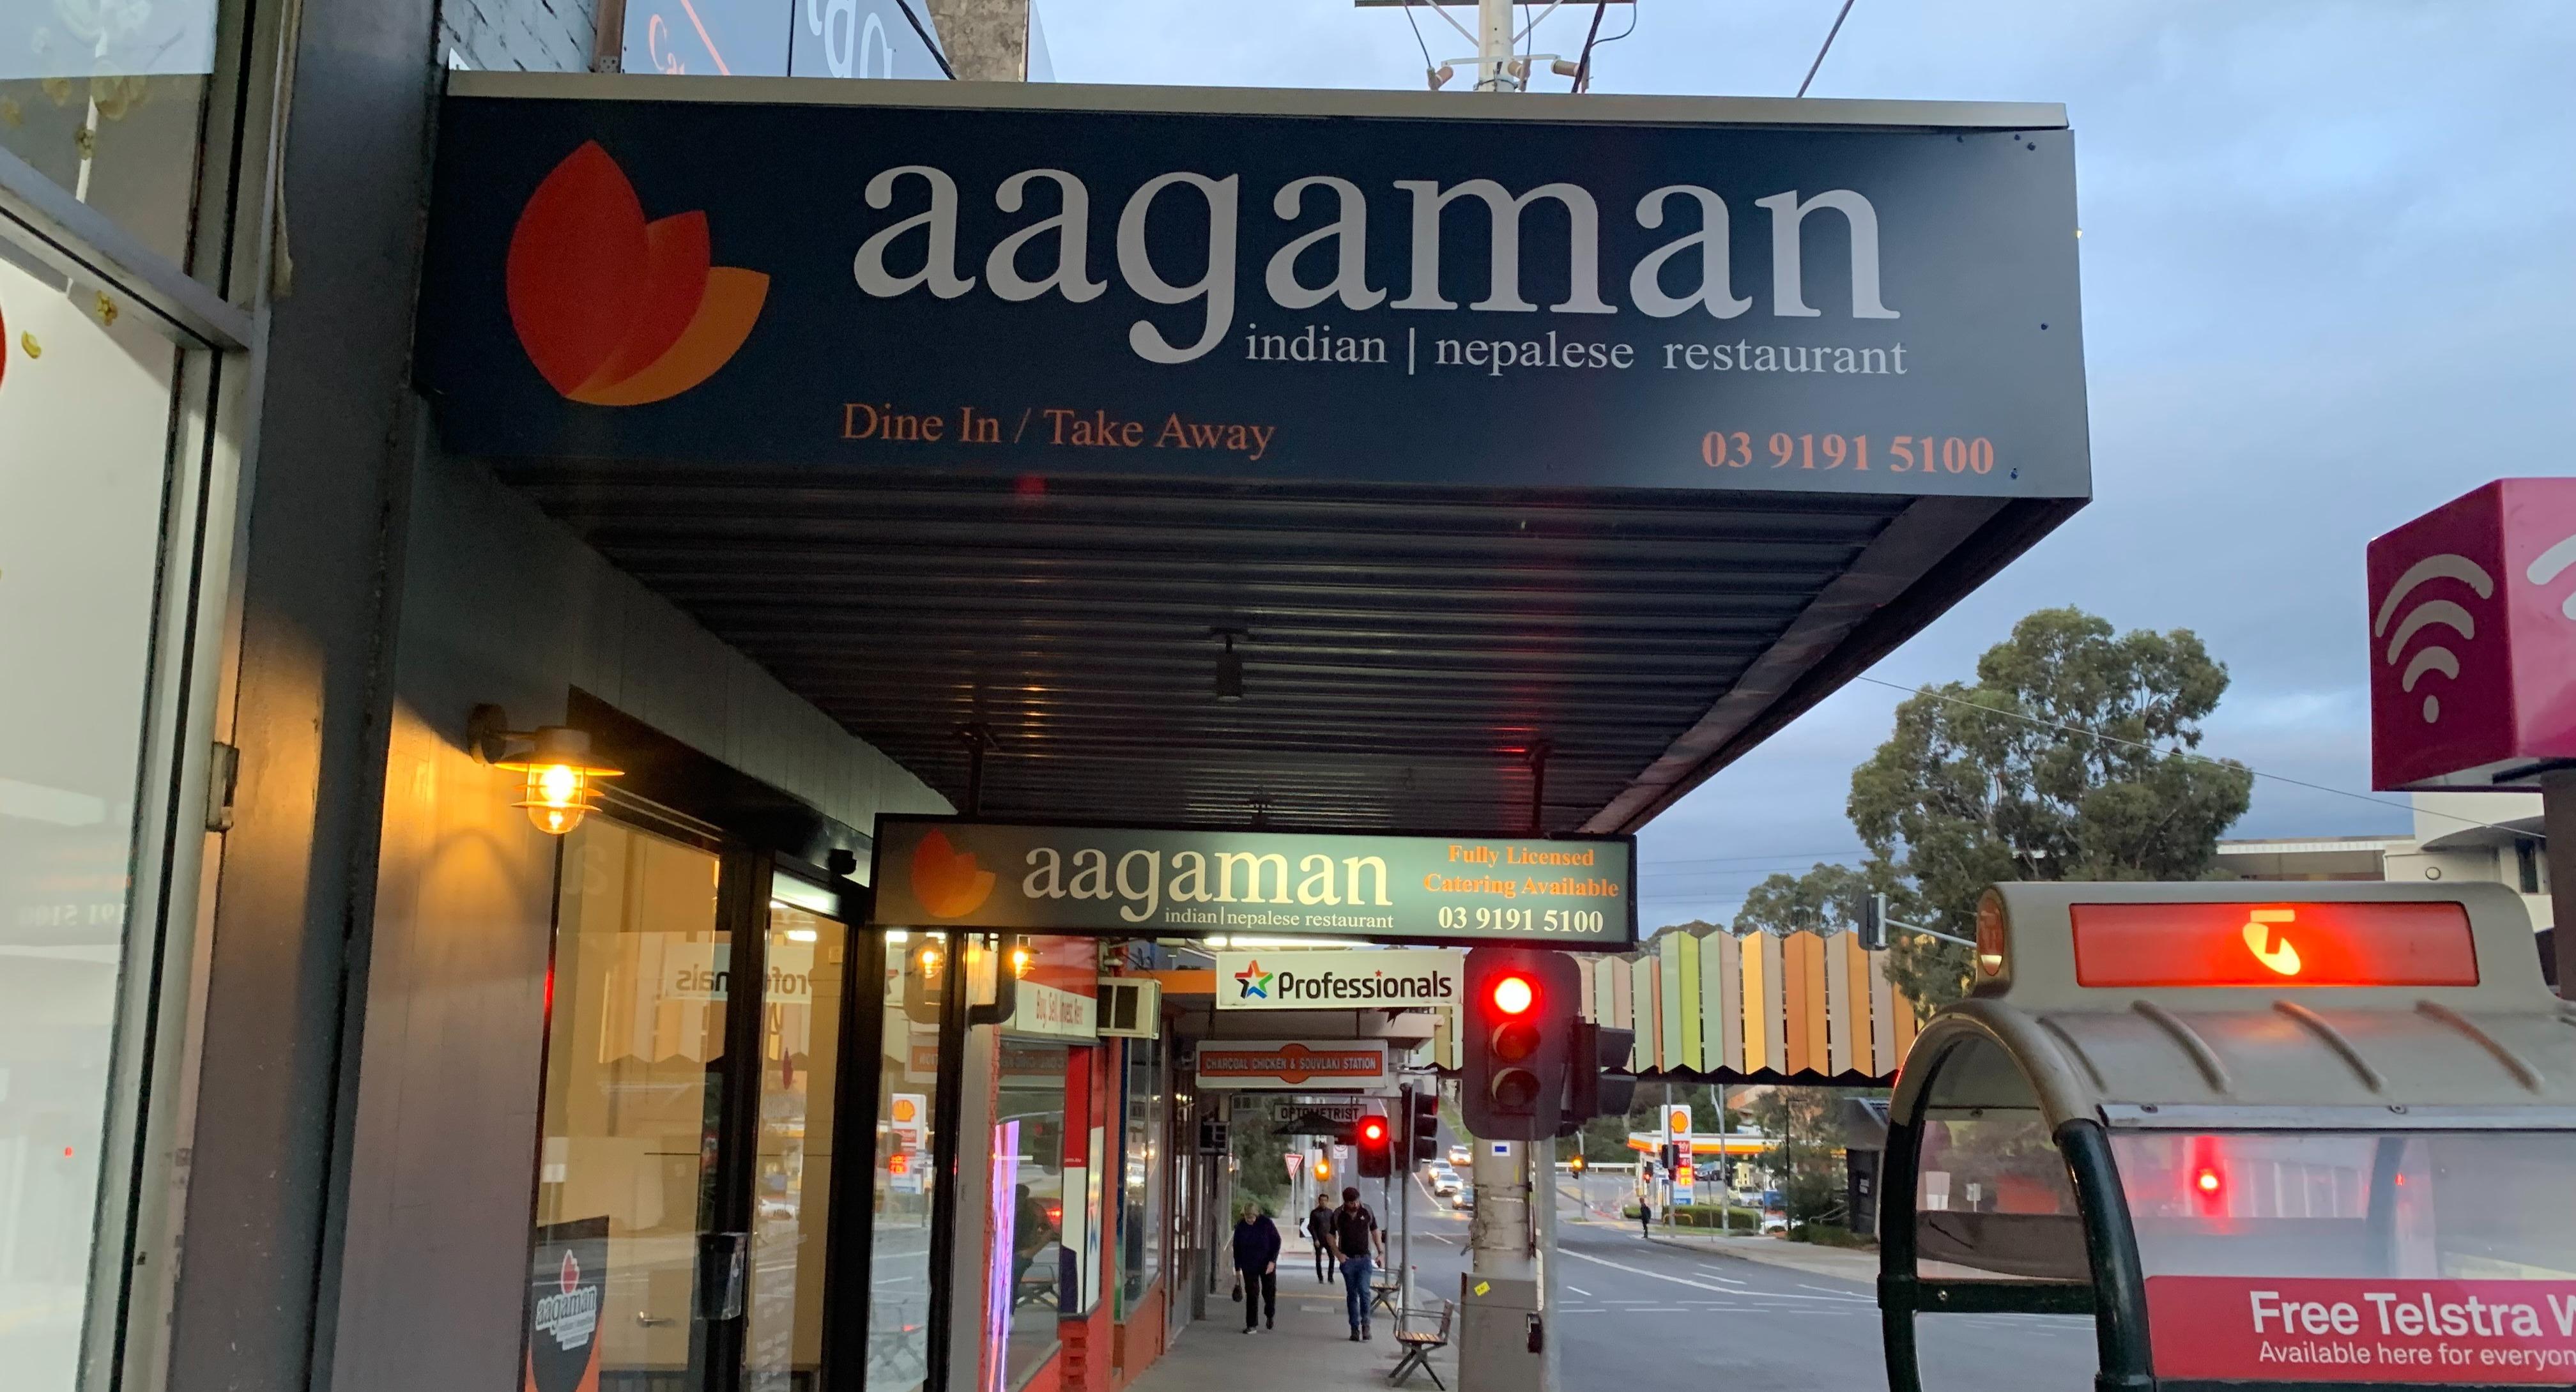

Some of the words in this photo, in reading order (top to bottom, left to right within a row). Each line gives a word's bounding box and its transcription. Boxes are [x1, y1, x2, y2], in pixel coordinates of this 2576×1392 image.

[853, 164, 1901, 364] aagaman
[1246, 323, 1388, 363] indian
[1435, 331, 1635, 376] nepalese
[1662, 340, 1908, 376] restaurant
[841, 403, 944, 442] Dine
[959, 406, 1002, 443] In
[1044, 409, 1144, 448] Take
[1155, 412, 1275, 461] Away
[1701, 431, 1752, 468] 03
[1769, 434, 1871, 470] 9191
[1890, 437, 1993, 474] 5100
[1448, 845, 1499, 868] Fully
[1506, 846, 1595, 866] Licensed
[1022, 847, 1393, 922] aagaman
[1423, 873, 1516, 899] Catering
[1521, 876, 1620, 898] Available
[1165, 907, 1217, 924] indian
[1227, 912, 1300, 928] nepalese
[1305, 915, 1393, 928] restaurant
[1438, 906, 1467, 929] 03
[1475, 907, 1533, 931] 9191
[1543, 909, 1604, 933] 5100
[1278, 970, 1452, 999] Professionals
[1206, 1058, 1248, 1070] CHARCOAL
[1252, 1058, 1287, 1070] CHICKEN
[1300, 1058, 1340, 1070] SOUVLAKI
[1344, 1058, 1376, 1070] STATION
[2250, 1291, 2359, 1335] Free
[2365, 1292, 2543, 1337] Telstra
[2260, 1341, 2370, 1363] Available
[2377, 1342, 2432, 1365] here
[2437, 1343, 2472, 1365] for
